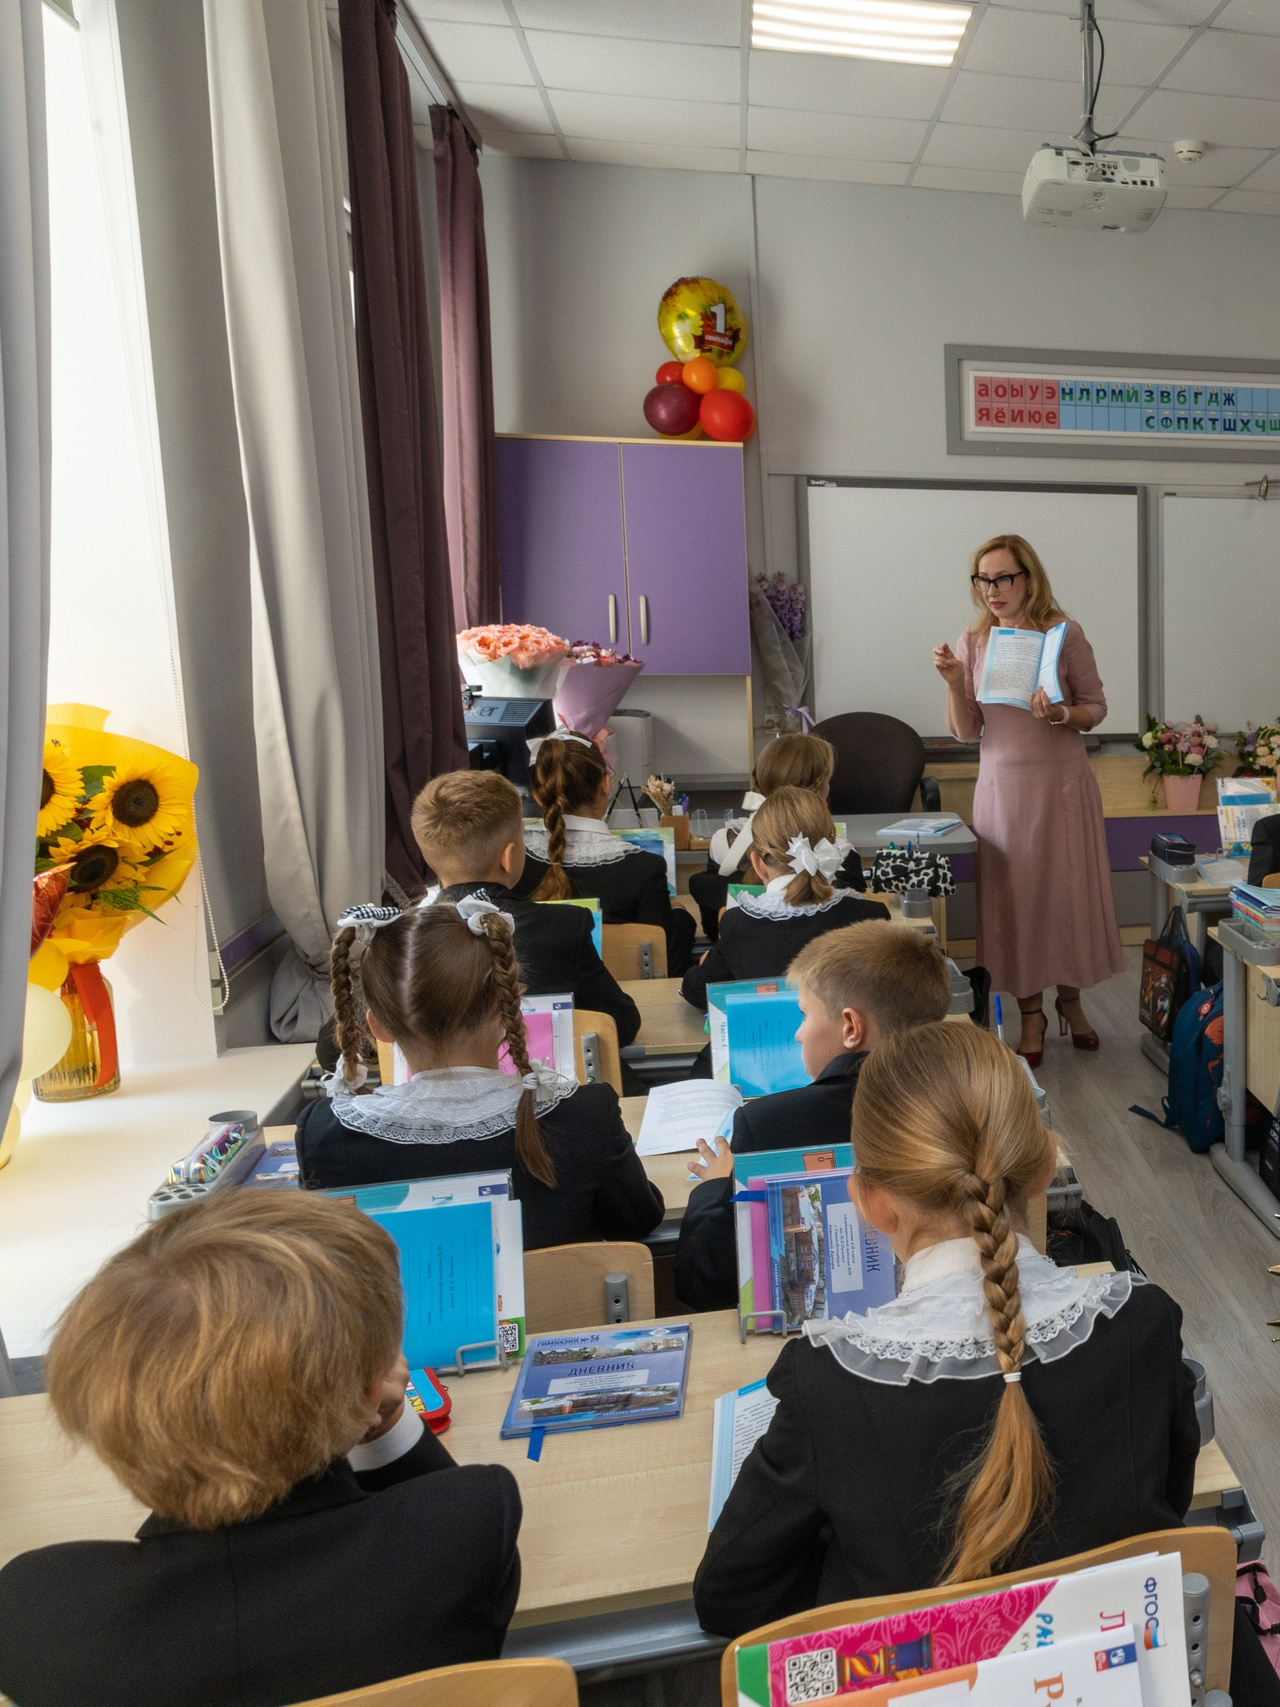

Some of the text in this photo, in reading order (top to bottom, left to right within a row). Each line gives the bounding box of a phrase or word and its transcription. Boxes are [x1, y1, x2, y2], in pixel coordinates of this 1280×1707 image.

[710, 303, 725, 333] 1
[537, 1338, 580, 1347] ГИМНАЗИЯ
[568, 1362, 636, 1377] ДНЕВНИК
[1143, 1577, 1159, 1630] ФГОС
